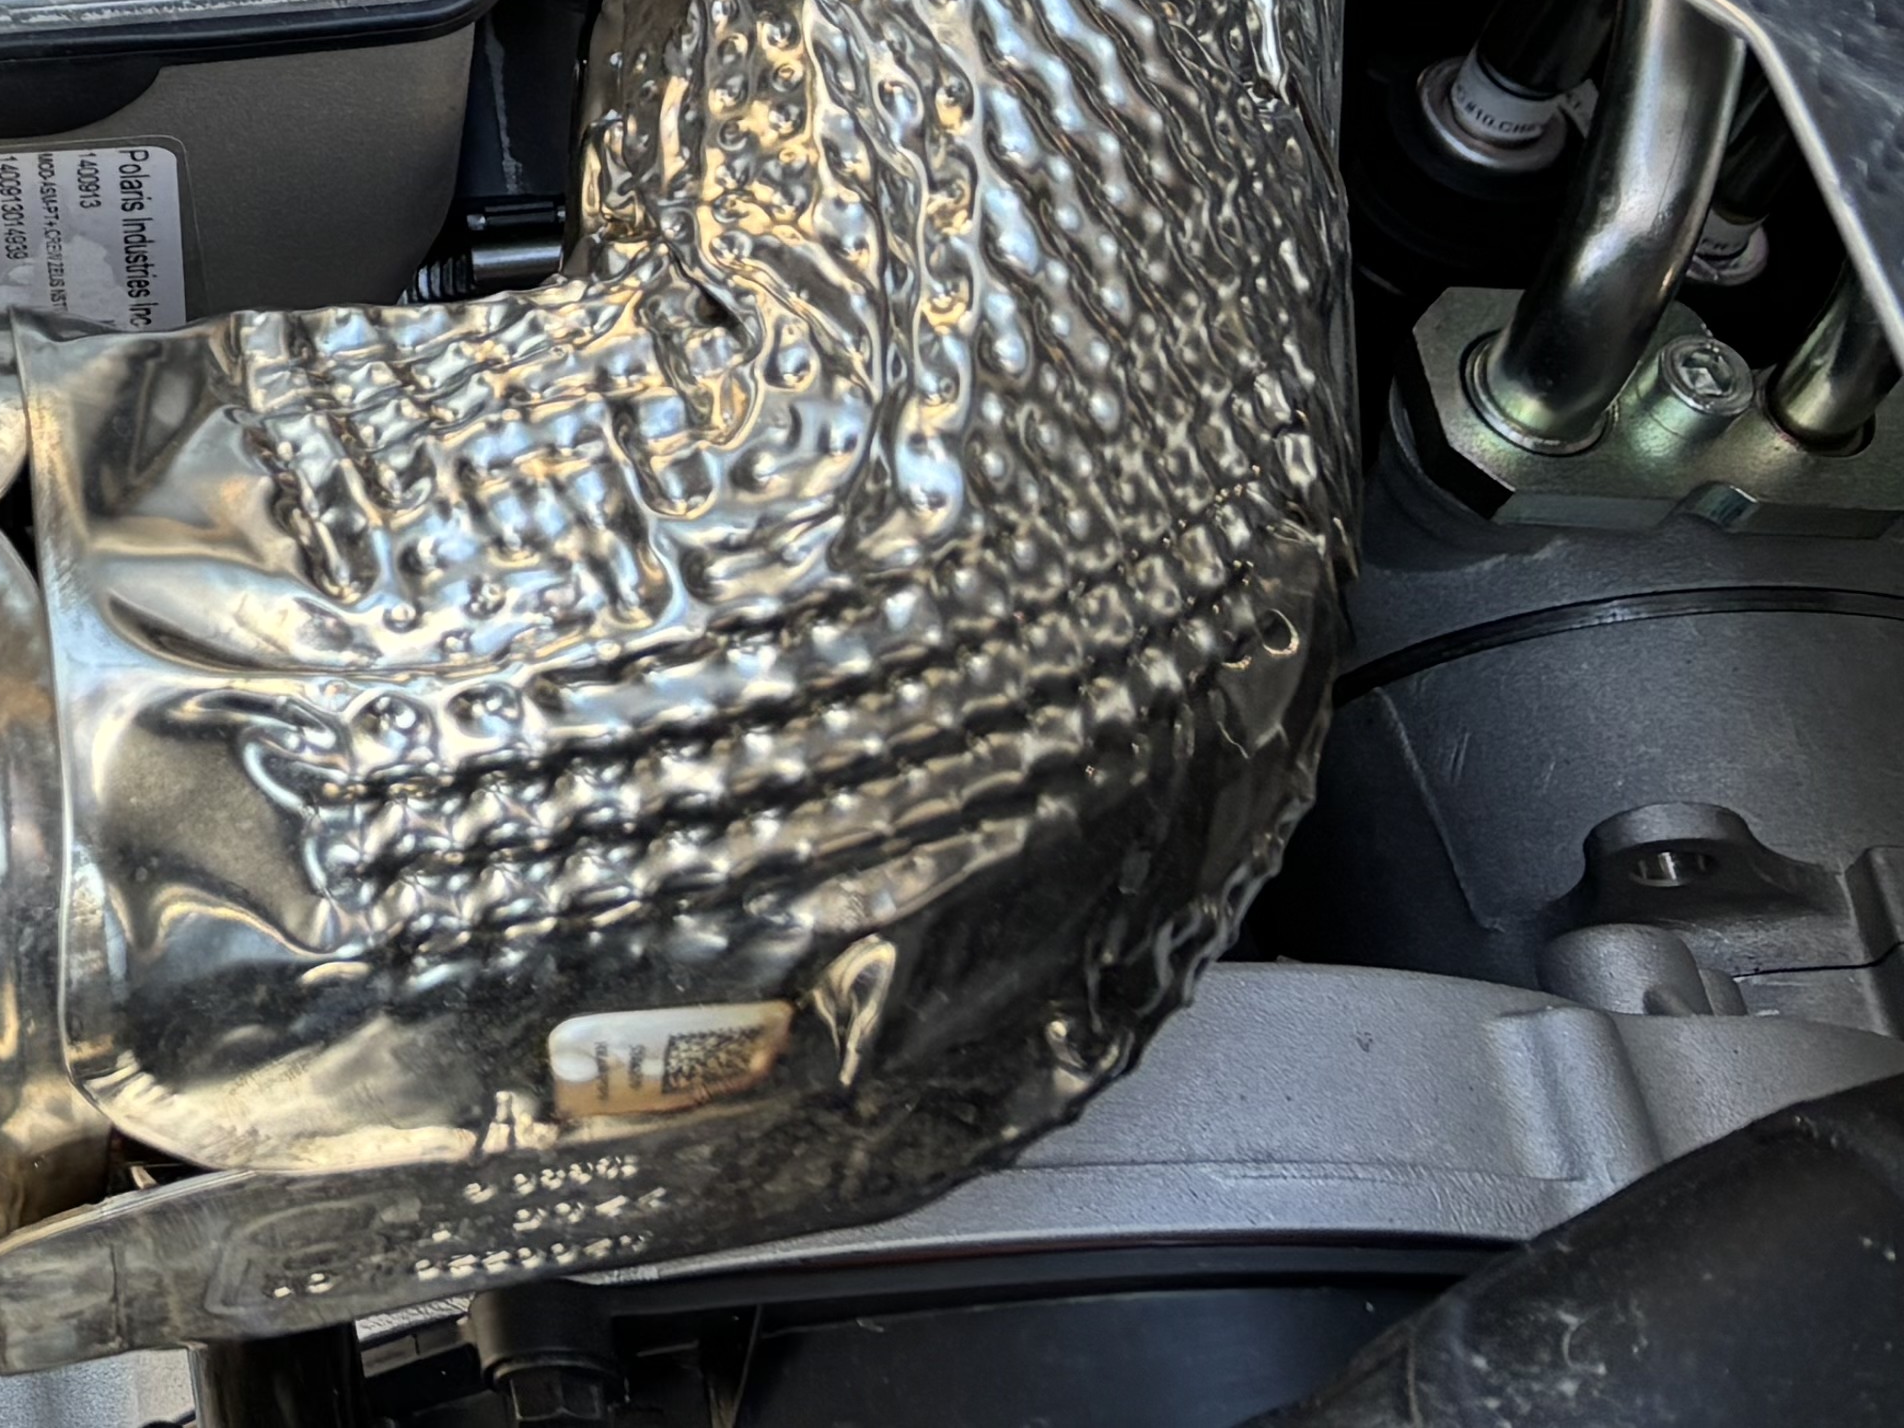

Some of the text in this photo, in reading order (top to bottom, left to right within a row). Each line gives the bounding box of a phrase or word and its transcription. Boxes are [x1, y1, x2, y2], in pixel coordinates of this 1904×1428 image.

[77, 152, 102, 210] 1400913
[118, 150, 152, 213] Polaris
[122, 218, 158, 299] Industries
